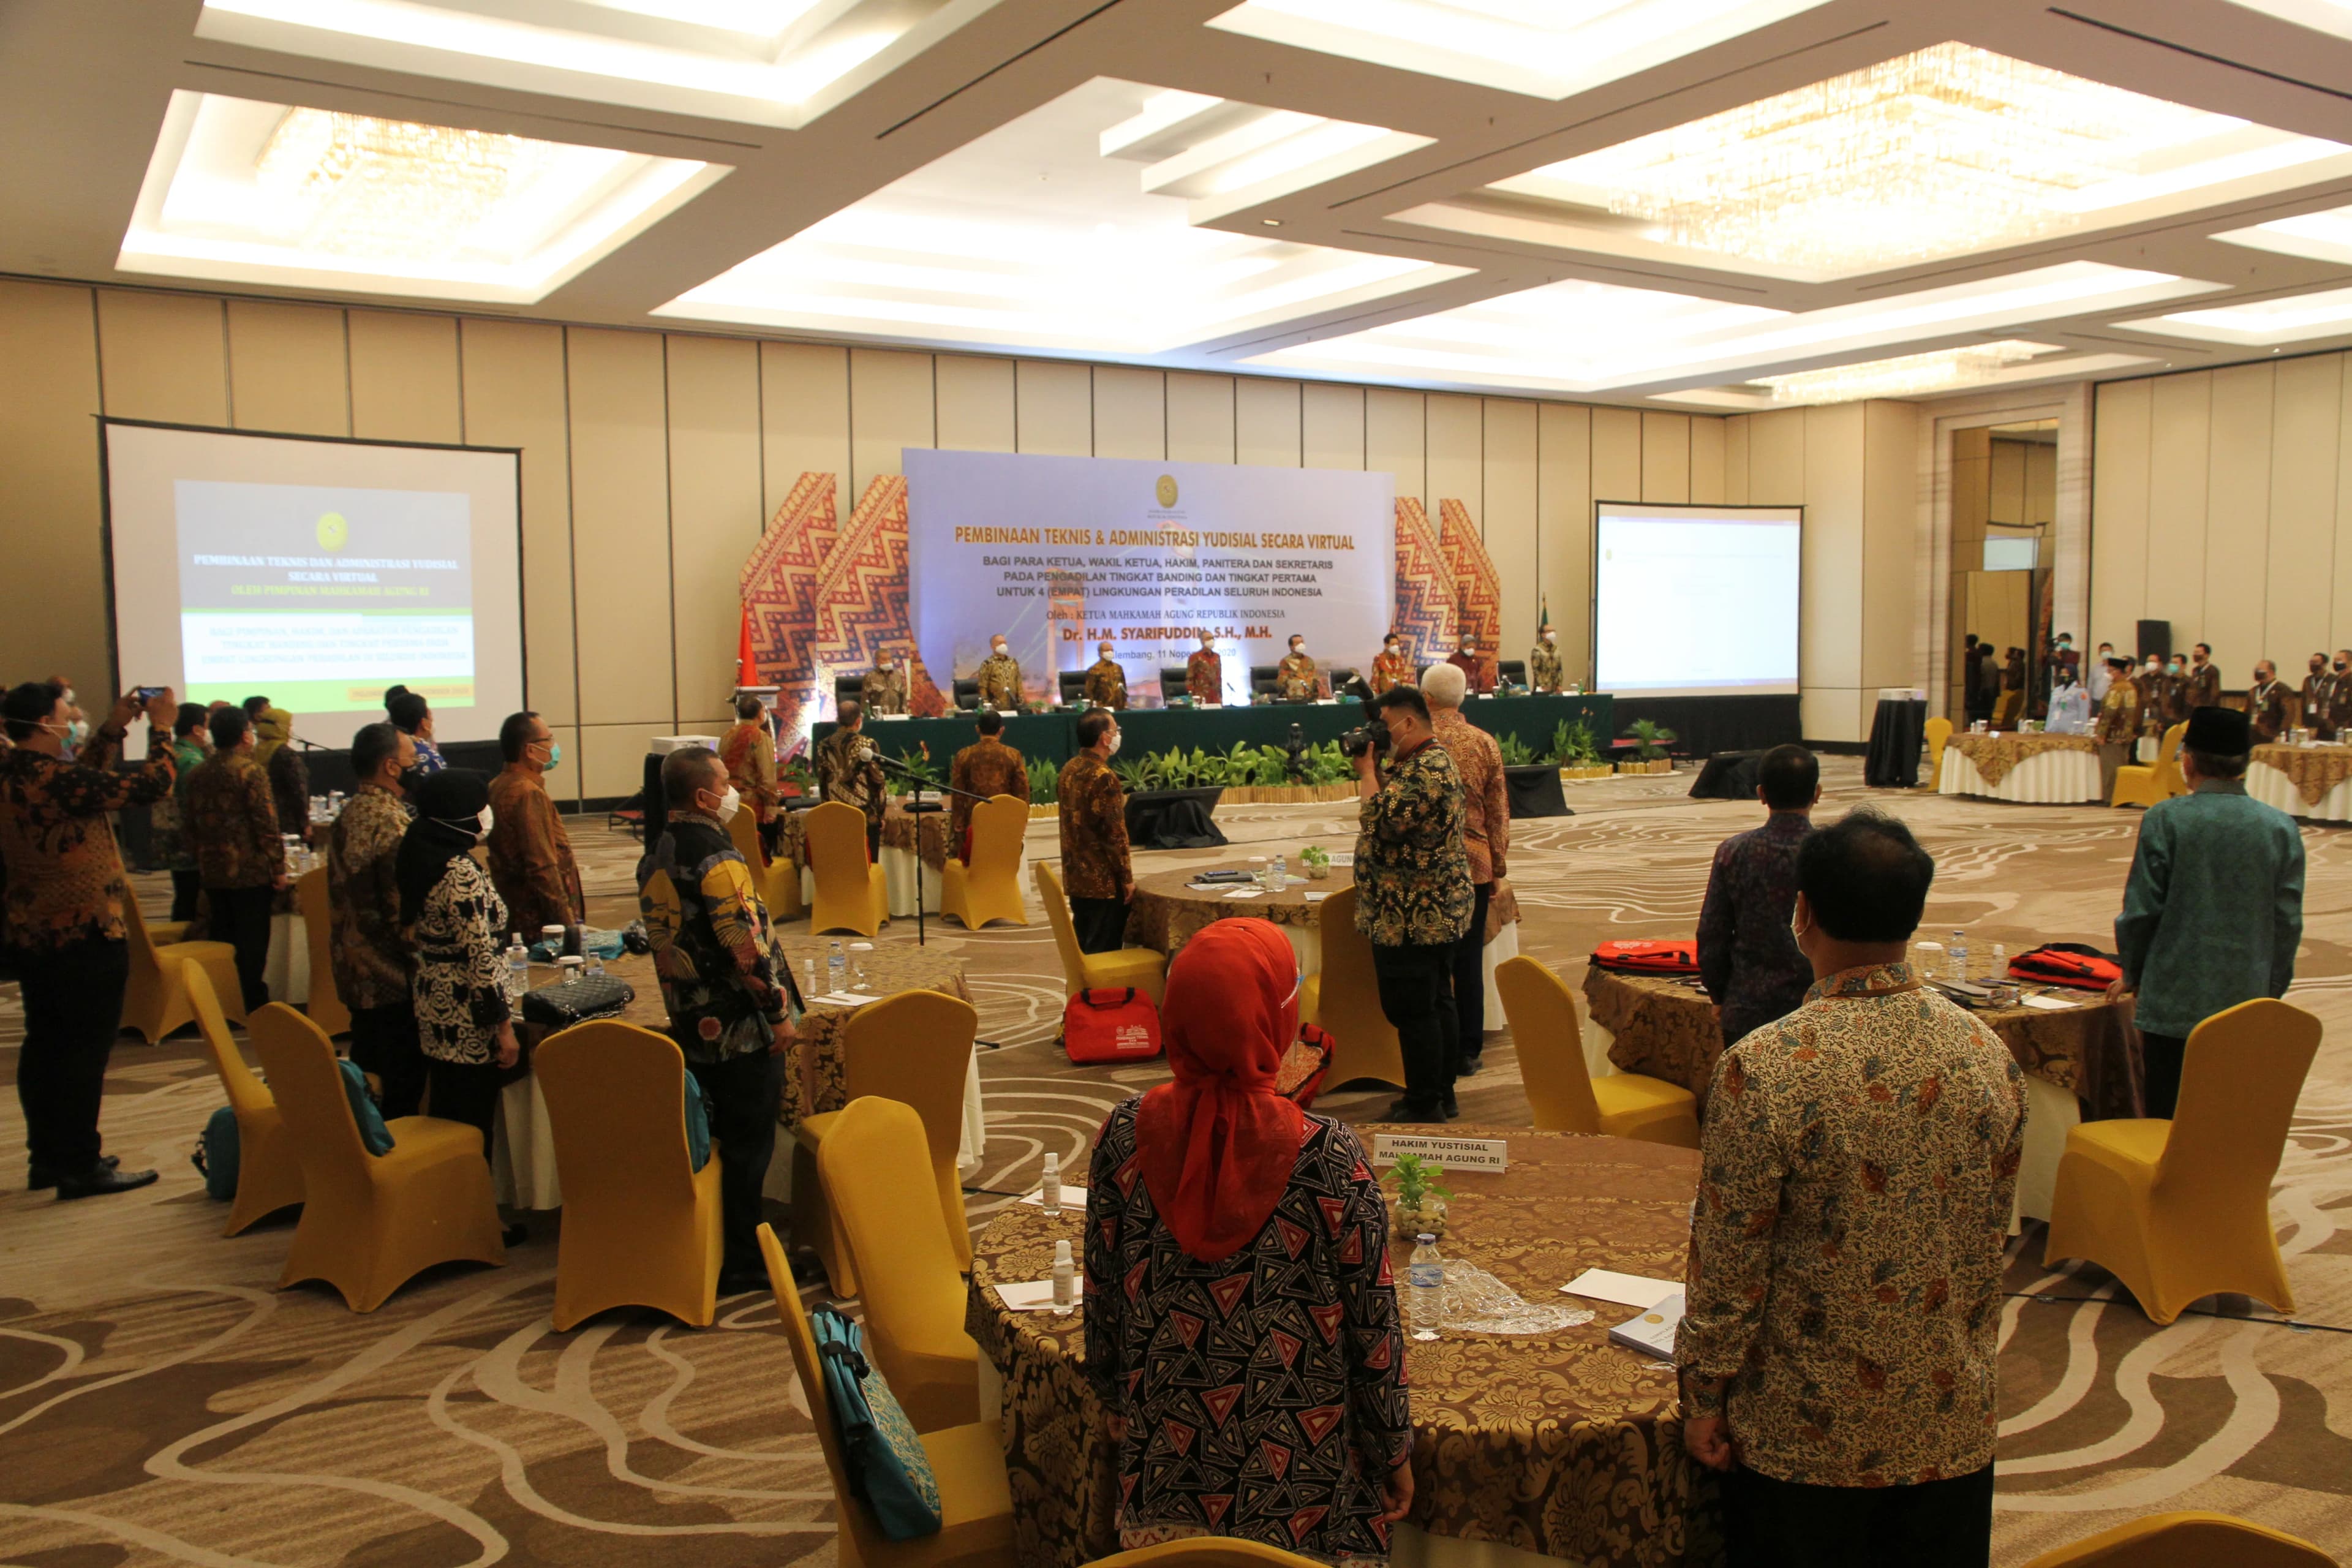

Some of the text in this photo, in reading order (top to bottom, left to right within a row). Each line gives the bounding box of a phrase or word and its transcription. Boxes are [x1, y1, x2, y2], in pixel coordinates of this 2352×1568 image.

[955, 526, 1355, 550] PEMBINAAN TEKNIS & ADMINISTRASI YUDISIAL SECARA VIRTUAL
[983, 556, 1333, 569] BAGI PARA KETUA, WAKIL KETUA, HAKIM, PANITERA DAN SEKRETARIS
[1004, 571, 1316, 583] PADA PENGADILAN TINGKAT BANDING DAN TINGKAT PERTAMA
[997, 587, 1322, 598] UNTUK 4 (EMPAT) LINGKUNGAN PERADILAN SELURUH INDONESIA
[1047, 610, 1068, 620] Oleh
[1076, 610, 1106, 620] KETUA
[1109, 610, 1161, 619] MAHKAMAH
[1164, 610, 1196, 619] AGUNG
[1196, 609, 1239, 619] REPUBLIK
[1240, 609, 1285, 618] INDONESIA
[1063, 628, 1082, 641] Dr.
[1087, 627, 1117, 641] H.M.
[1245, 625, 1272, 638] M.H.
[1392, 1139, 1489, 1152] HAKIM YUSTISIAL
[1446, 1154, 1485, 1164] AGUNG
